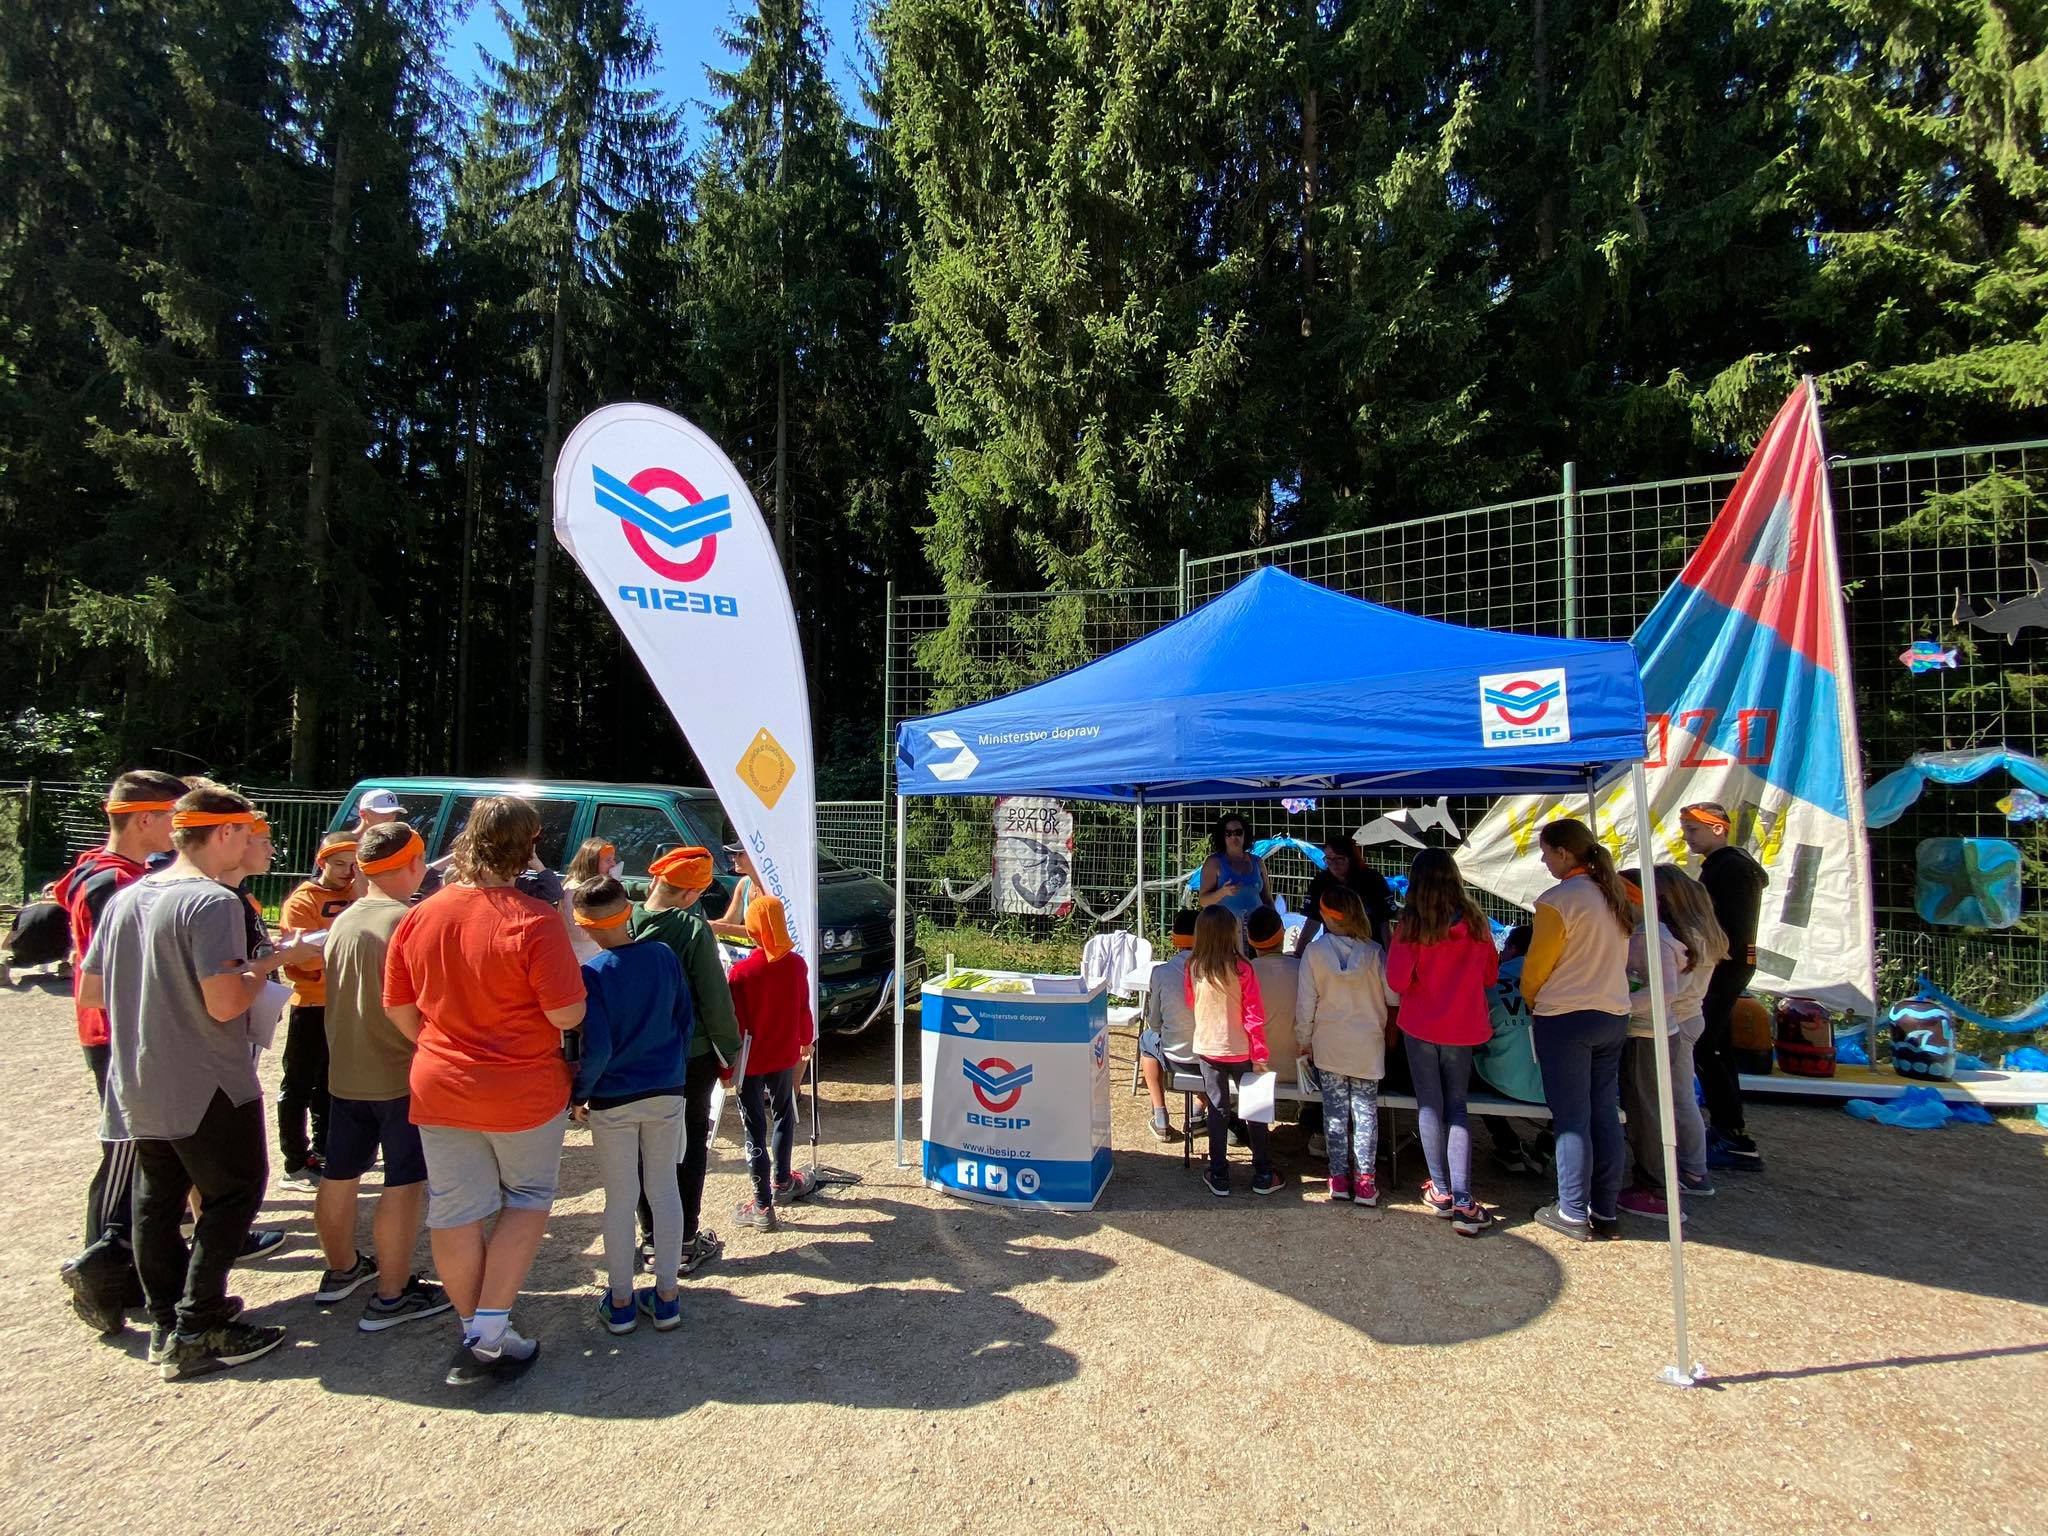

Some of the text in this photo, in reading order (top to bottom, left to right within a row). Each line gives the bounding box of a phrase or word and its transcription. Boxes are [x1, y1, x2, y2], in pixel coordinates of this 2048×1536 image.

[978, 725, 1100, 745] Ministerstvo dopravy
[1492, 726, 1561, 741] BESIP
[1009, 808, 1058, 821] POZOR
[979, 1012, 1046, 1022] Ministerstvo dopravy
[967, 1112, 1031, 1130] BESIP
[962, 1142, 1031, 1158] www.ibesip.cz
